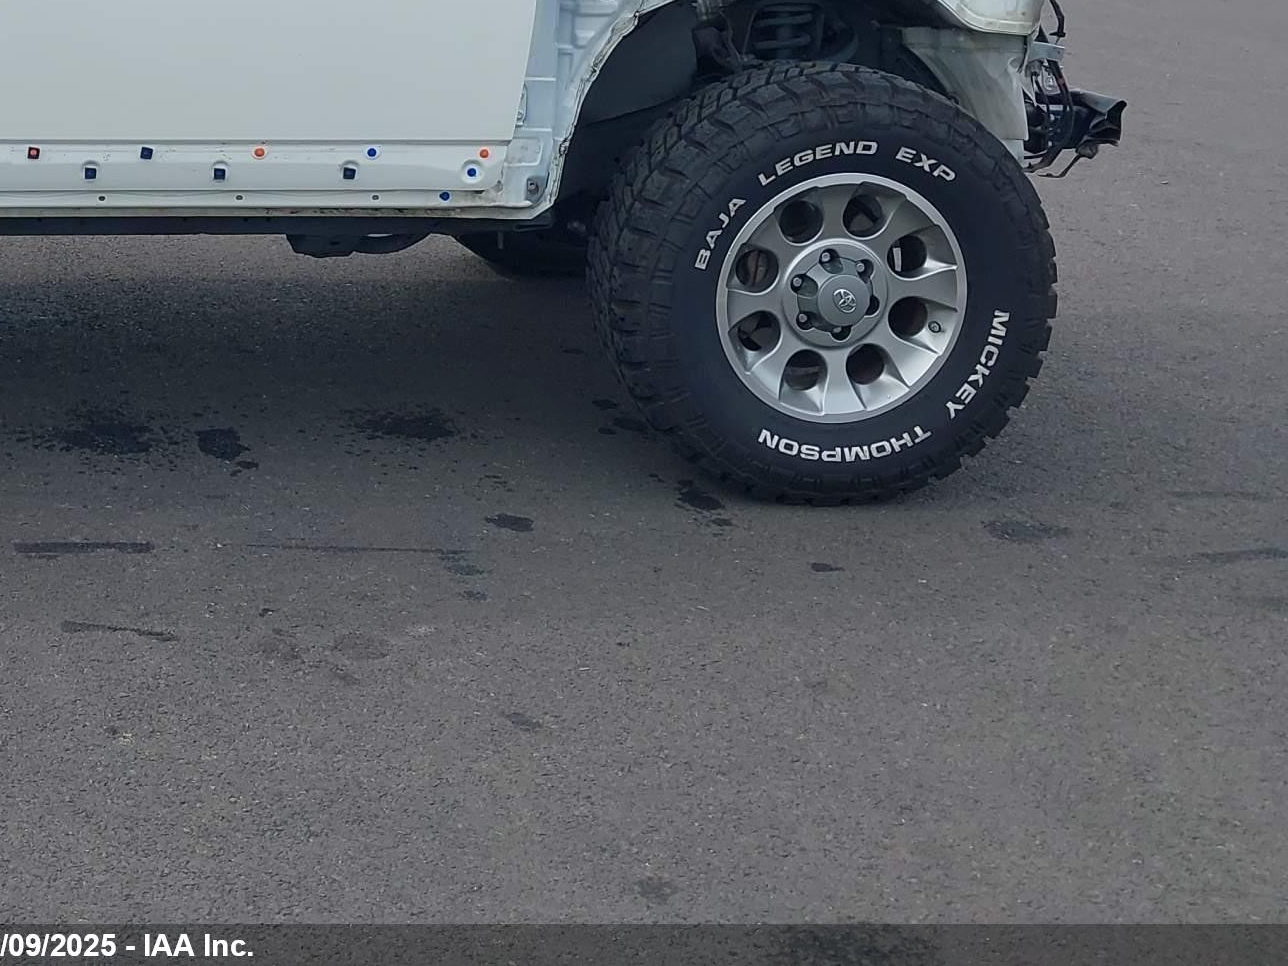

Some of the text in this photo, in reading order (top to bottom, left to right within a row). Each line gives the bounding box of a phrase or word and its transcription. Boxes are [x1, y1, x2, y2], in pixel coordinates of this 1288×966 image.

[694, 140, 957, 271] BAJA LEGEND EXP
[757, 309, 1011, 462] MICKEY THOMPSON
